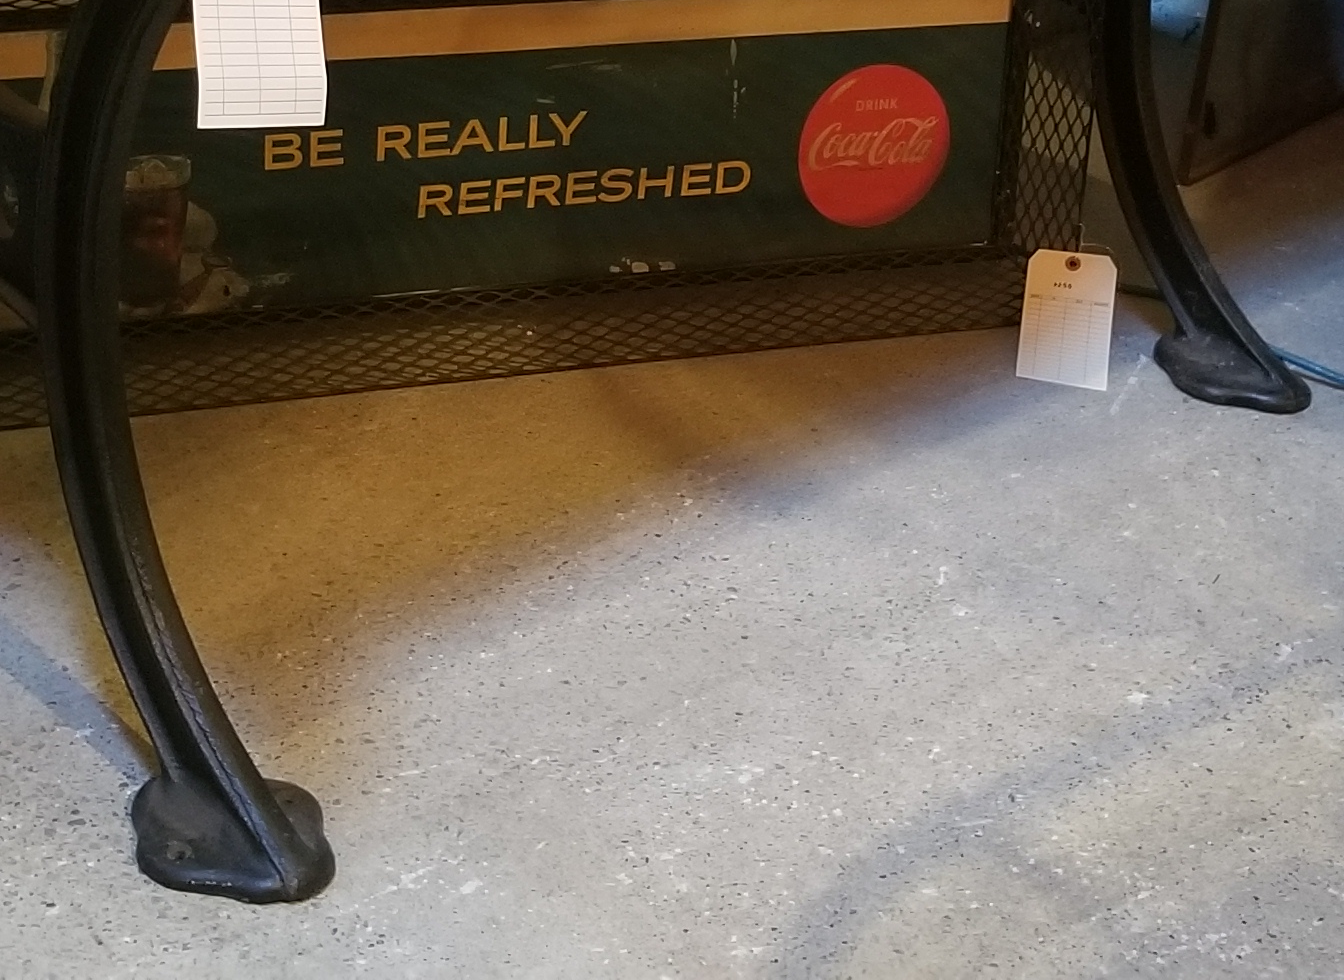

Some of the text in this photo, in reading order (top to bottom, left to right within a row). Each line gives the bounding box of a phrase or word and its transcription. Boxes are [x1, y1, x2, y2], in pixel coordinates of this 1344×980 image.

[856, 98, 898, 112] DRINK
[264, 110, 588, 171] BE REALLY
[808, 116, 939, 171] Coca-Cola
[417, 160, 752, 219] REFRESHED
